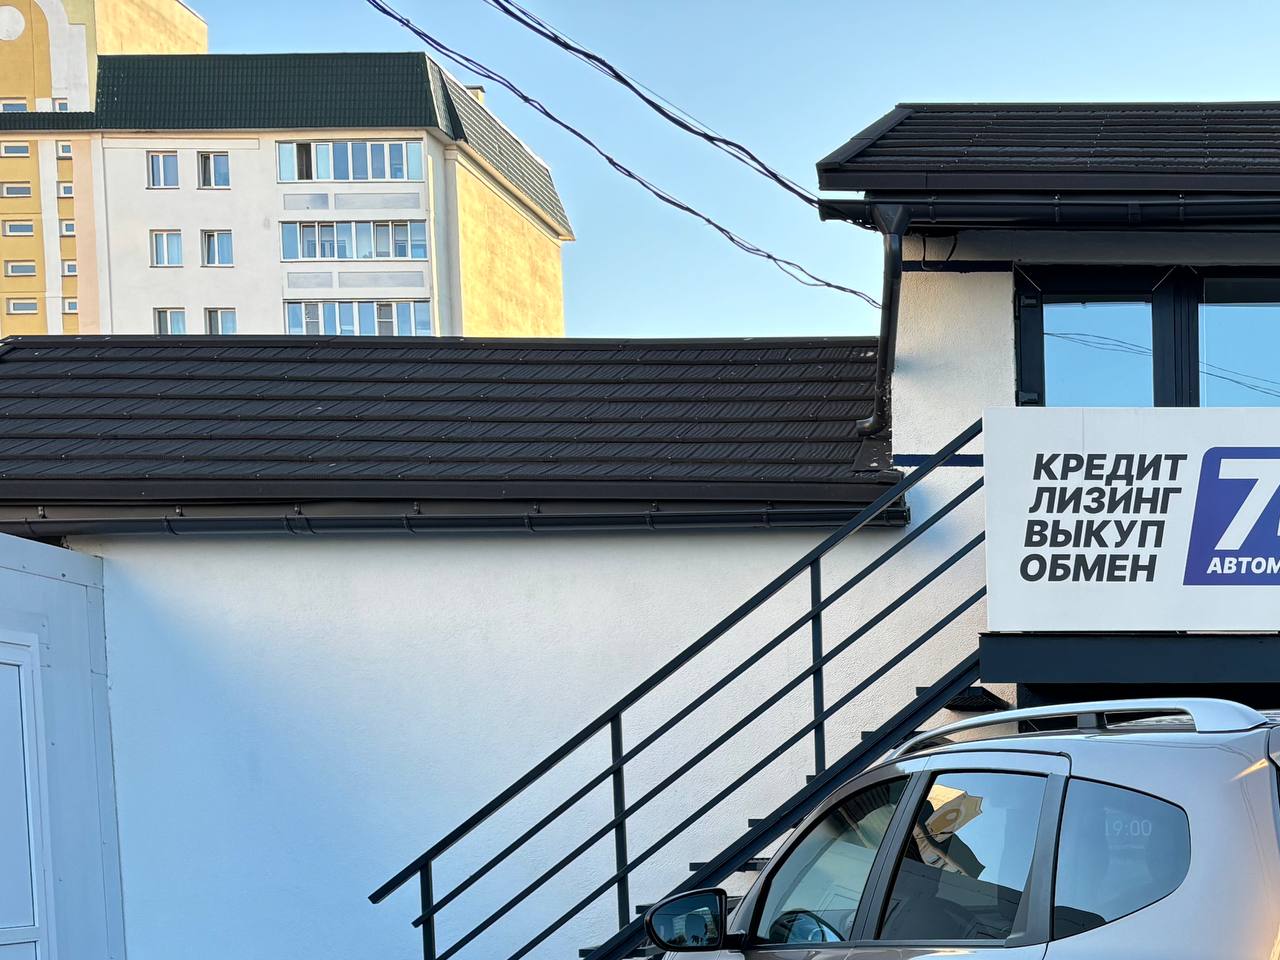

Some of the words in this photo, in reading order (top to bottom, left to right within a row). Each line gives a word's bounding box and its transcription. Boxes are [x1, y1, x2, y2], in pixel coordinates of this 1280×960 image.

[1033, 453, 1188, 487] КРЕДИТ
[1028, 486, 1183, 514] ЛИЗИНГ
[1024, 519, 1166, 549] ВЫКУП
[1019, 553, 1158, 583] ОБМЕН
